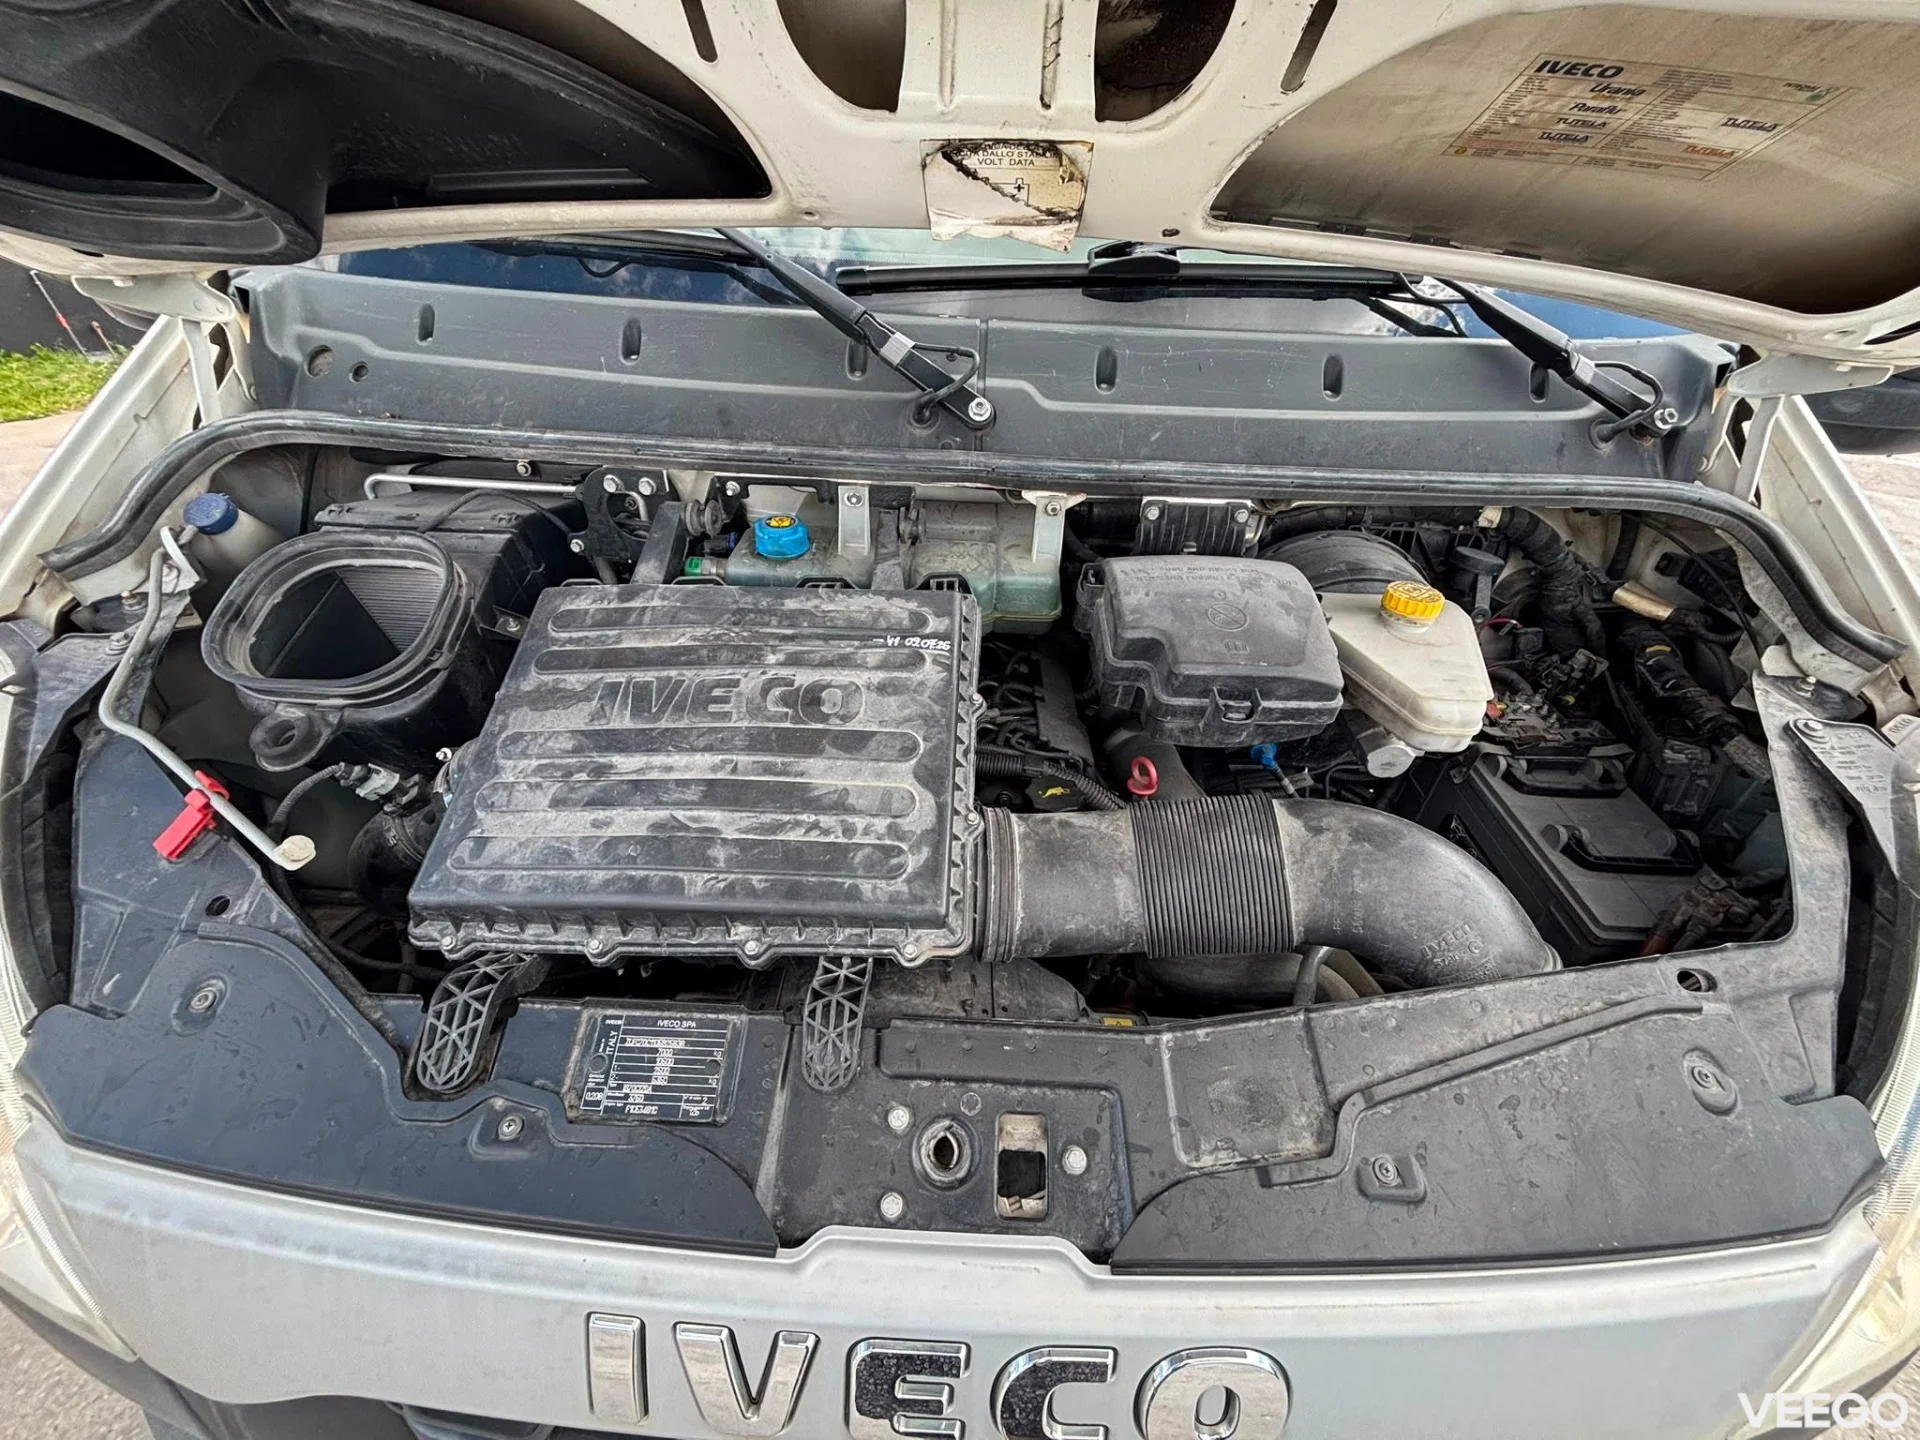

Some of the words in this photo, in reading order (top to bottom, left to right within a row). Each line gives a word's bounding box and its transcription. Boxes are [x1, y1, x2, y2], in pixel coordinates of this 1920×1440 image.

[1533, 60, 1625, 79] IVECO
[1589, 82, 1646, 97] Urania
[1720, 117, 1778, 132] TUTELA
[977, 158, 1004, 166] VOLT
[1008, 158, 1036, 167] DATA
[590, 676, 865, 726] IVECO
[656, 1019, 681, 1029] IVECO
[681, 1020, 697, 1029] SPA
[605, 1030, 618, 1055] ITALY
[656, 1048, 673, 1057] 7000
[701, 1096, 708, 1106] 2
[586, 1310, 1293, 1440] IVECO
